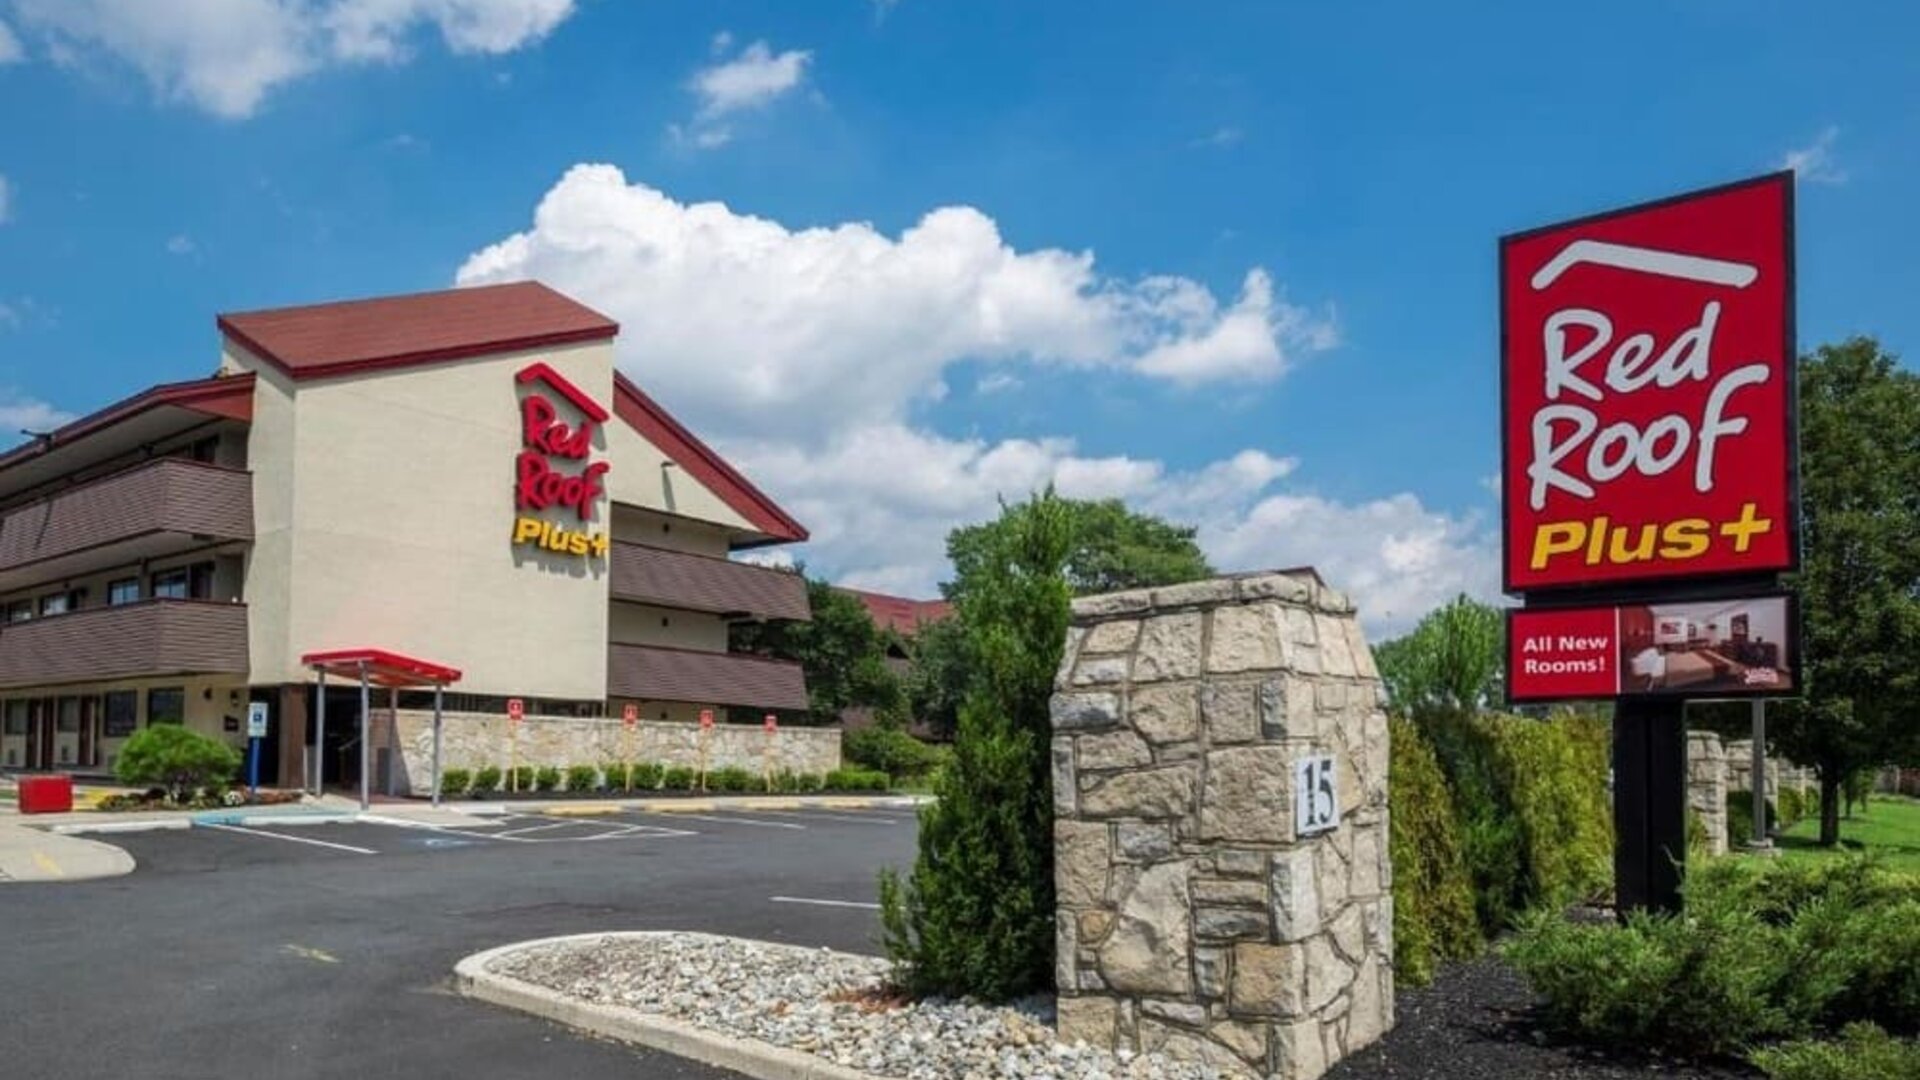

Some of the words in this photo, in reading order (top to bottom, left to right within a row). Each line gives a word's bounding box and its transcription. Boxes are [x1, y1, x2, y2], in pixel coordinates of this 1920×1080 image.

[1543, 301, 1721, 400] Red
[521, 395, 594, 460] Red
[1527, 364, 1770, 511] Roof
[515, 451, 610, 521] Roof
[514, 517, 608, 557] Plus+
[1530, 503, 1771, 570] Plus+
[1523, 636, 1551, 652] All
[1558, 636, 1608, 651] New
[1524, 656, 1606, 674] Rooms!
[1304, 760, 1334, 826] 15
